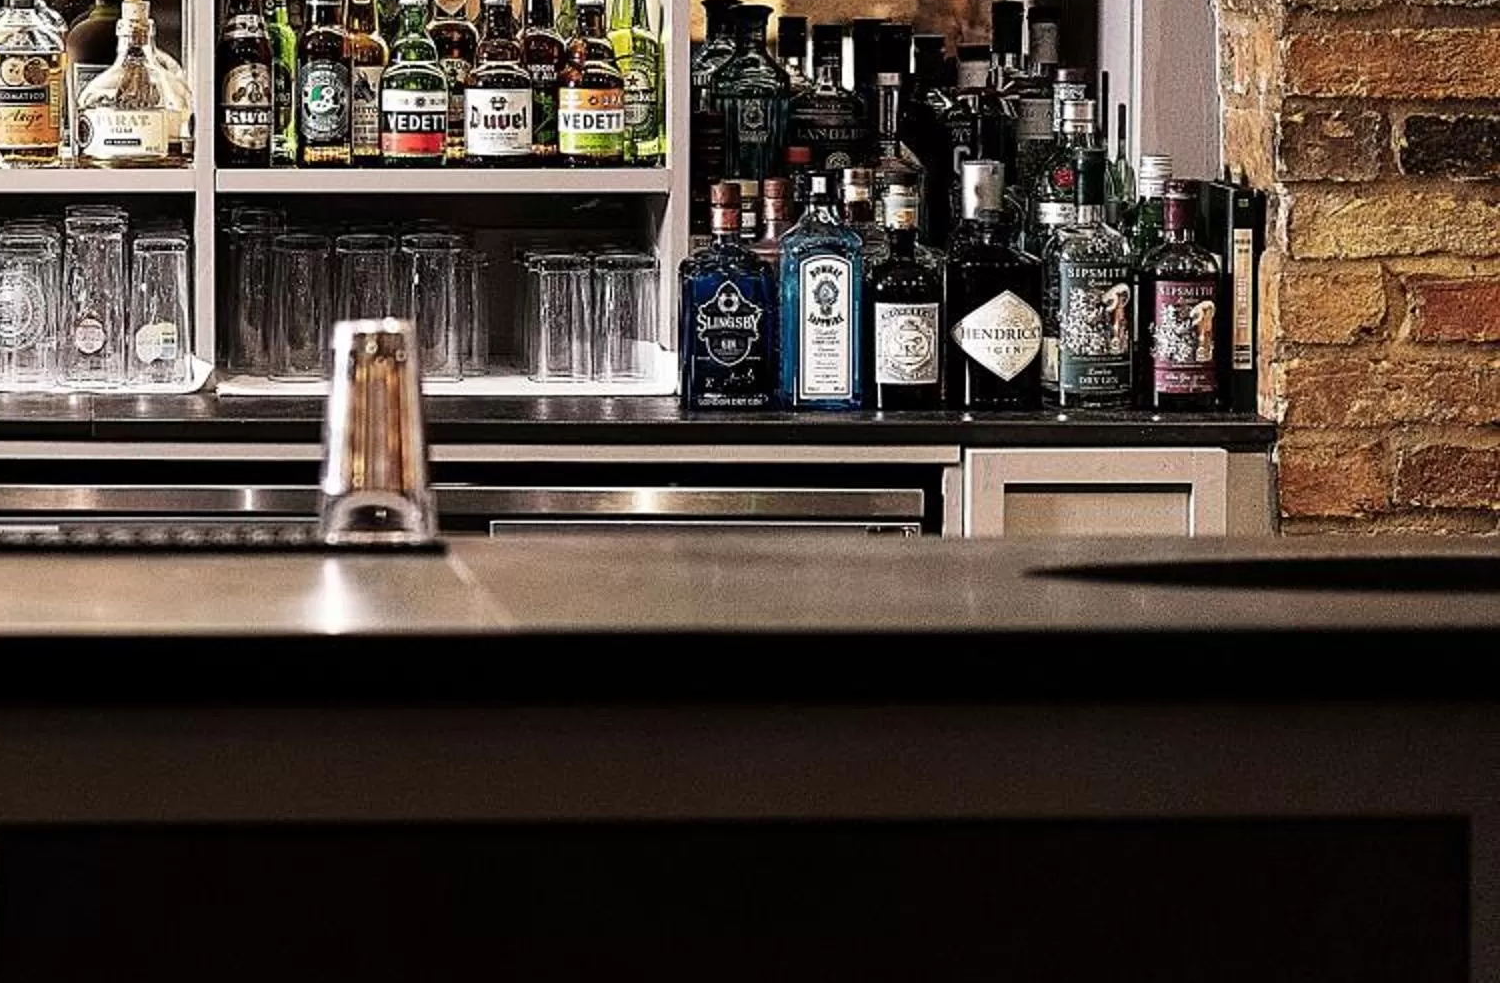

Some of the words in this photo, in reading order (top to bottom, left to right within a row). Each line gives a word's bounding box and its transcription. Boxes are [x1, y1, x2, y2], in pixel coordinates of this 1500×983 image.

[469, 104, 528, 131] Duvel
[1158, 286, 1215, 296] SIPSMITH
[696, 315, 761, 332] SLINGSBY
